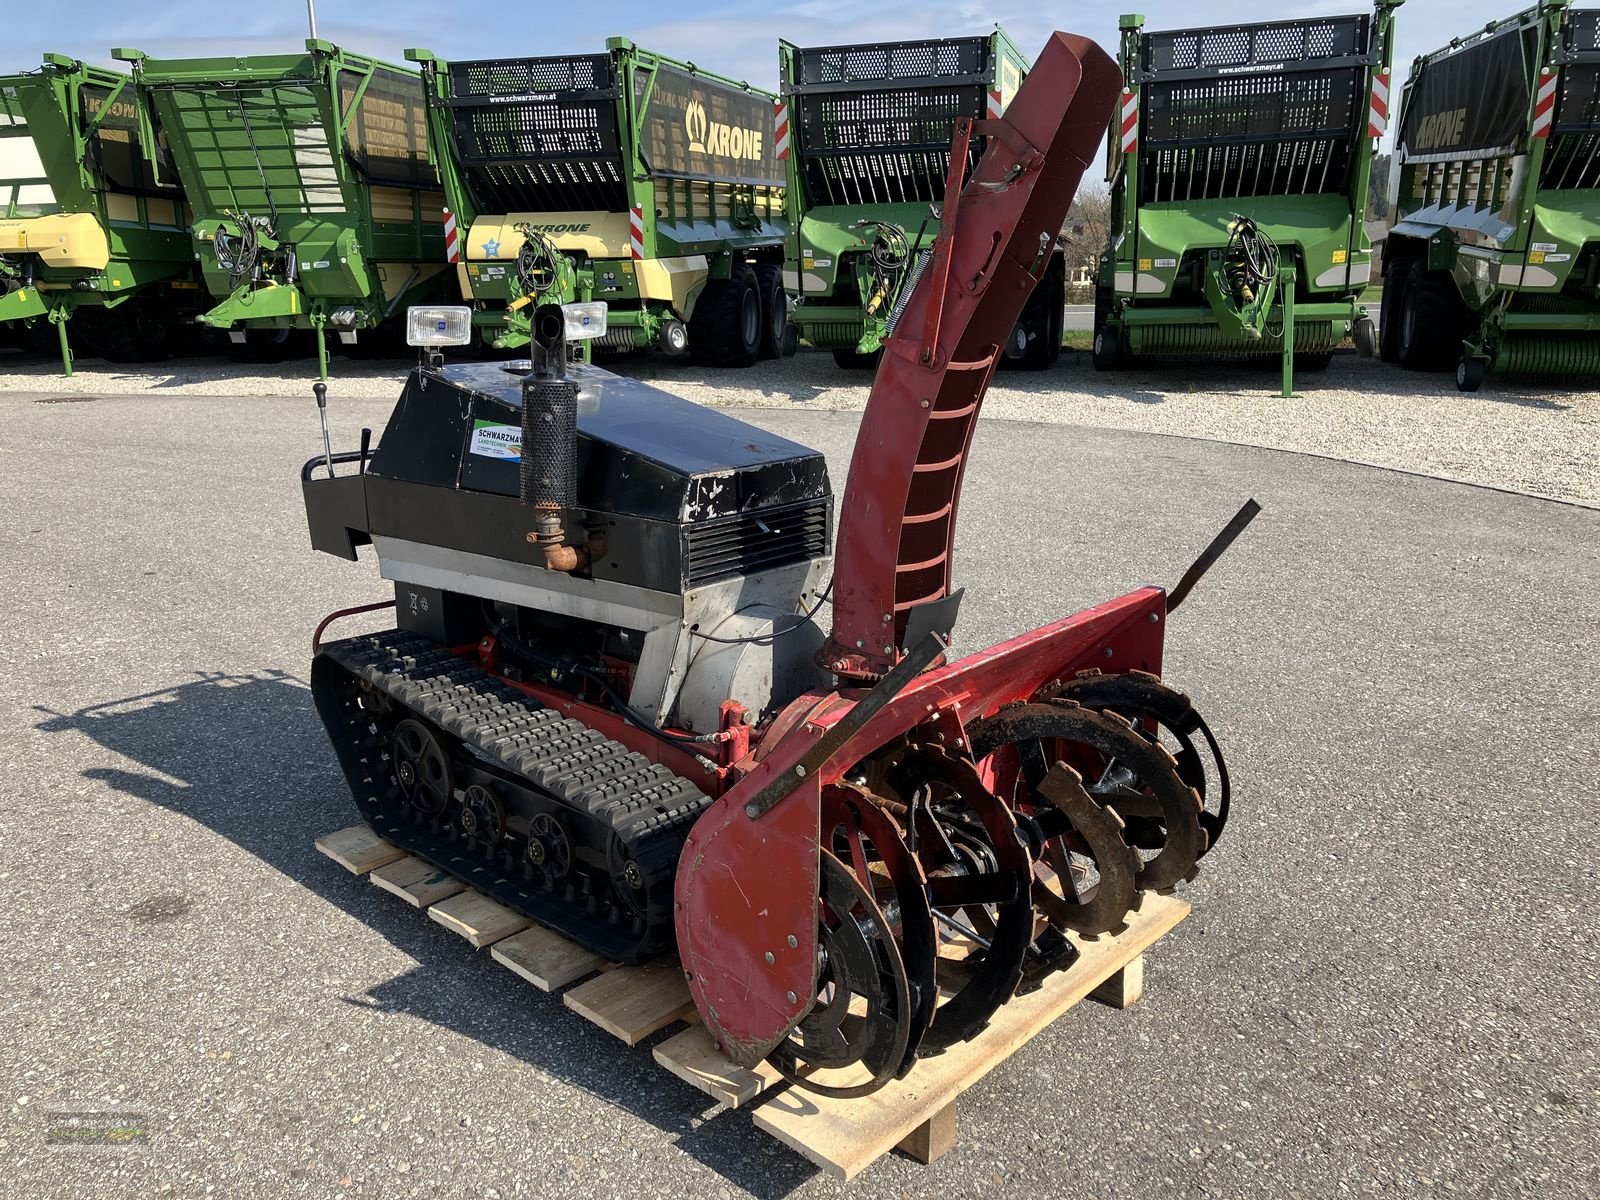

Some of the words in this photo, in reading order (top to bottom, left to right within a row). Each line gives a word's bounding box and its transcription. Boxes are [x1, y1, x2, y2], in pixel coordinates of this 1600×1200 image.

[1218, 63, 1284, 74] www.schwarzmayr.at
[89, 98, 138, 119] KON
[1415, 108, 1467, 150] KRONE
[707, 121, 763, 161] KRONE
[532, 223, 591, 233] KRONE
